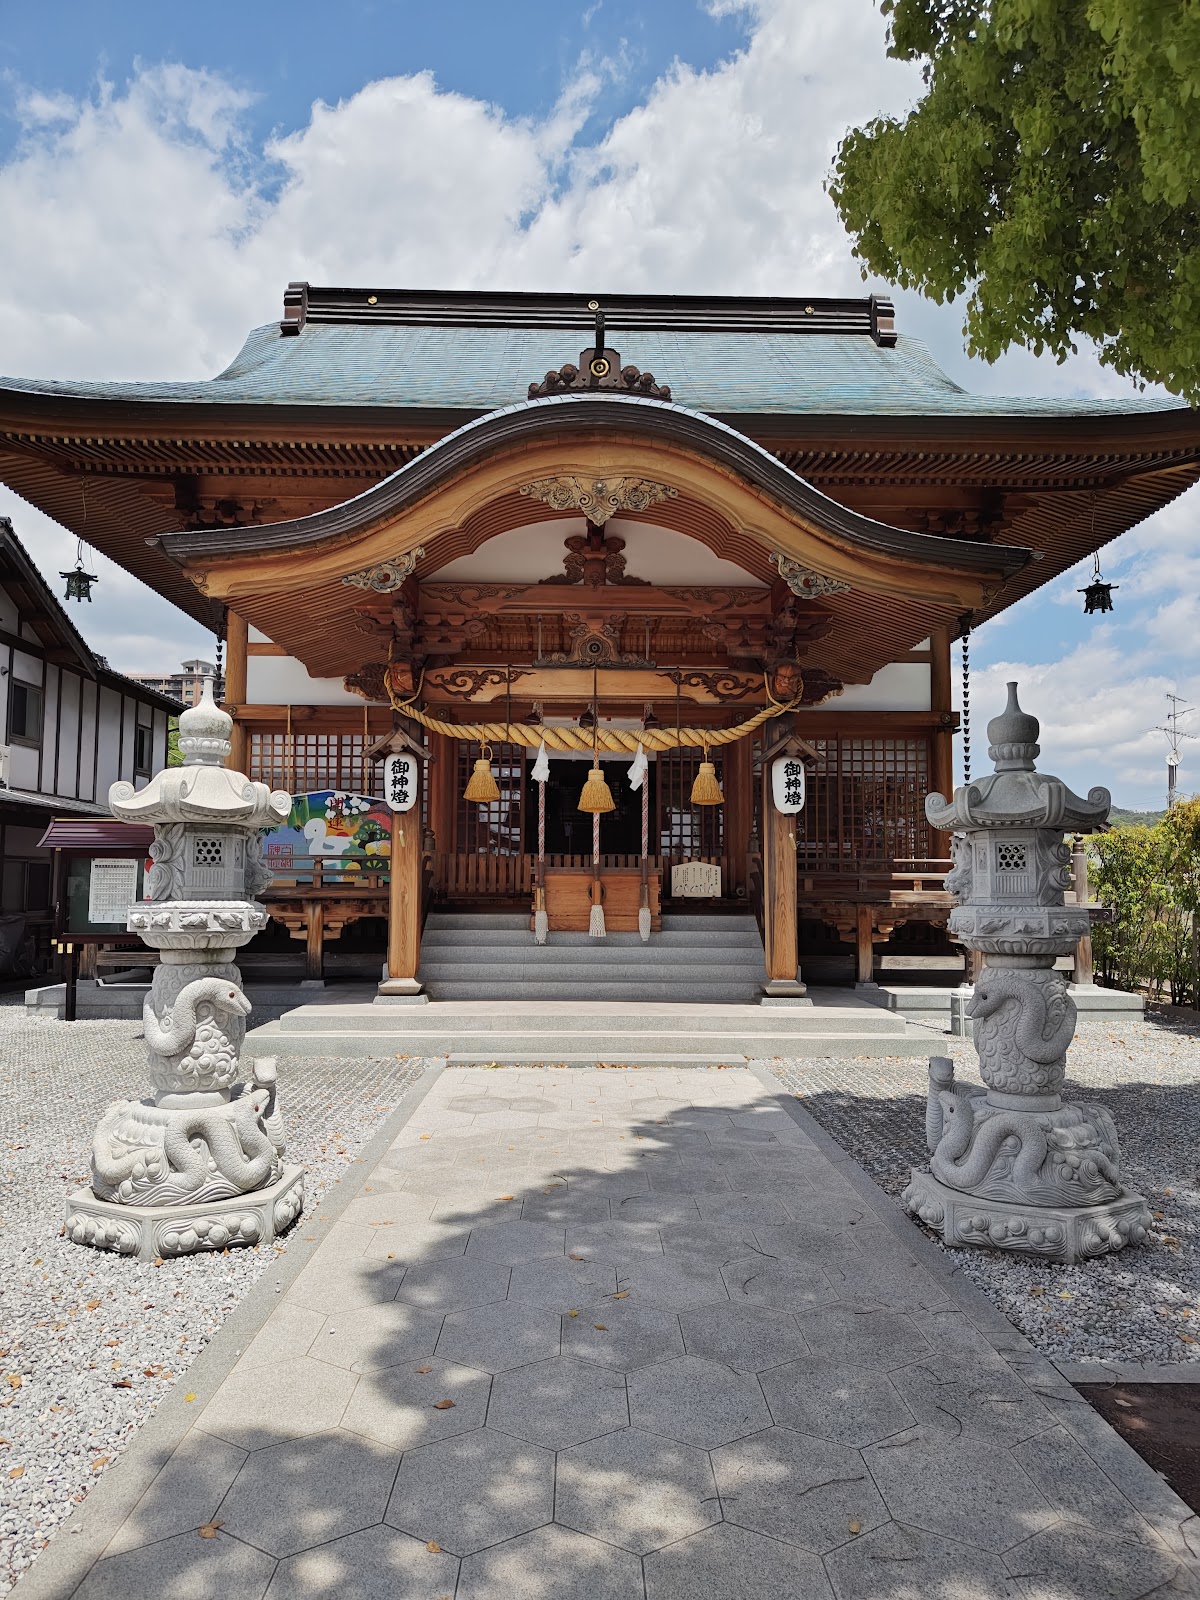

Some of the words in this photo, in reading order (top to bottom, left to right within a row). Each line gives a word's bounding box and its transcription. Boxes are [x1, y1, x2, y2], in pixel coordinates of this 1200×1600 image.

[391, 759, 409, 803] 御神燈
[784, 761, 801, 805] 御神燈
[328, 797, 344, 830] 開運
